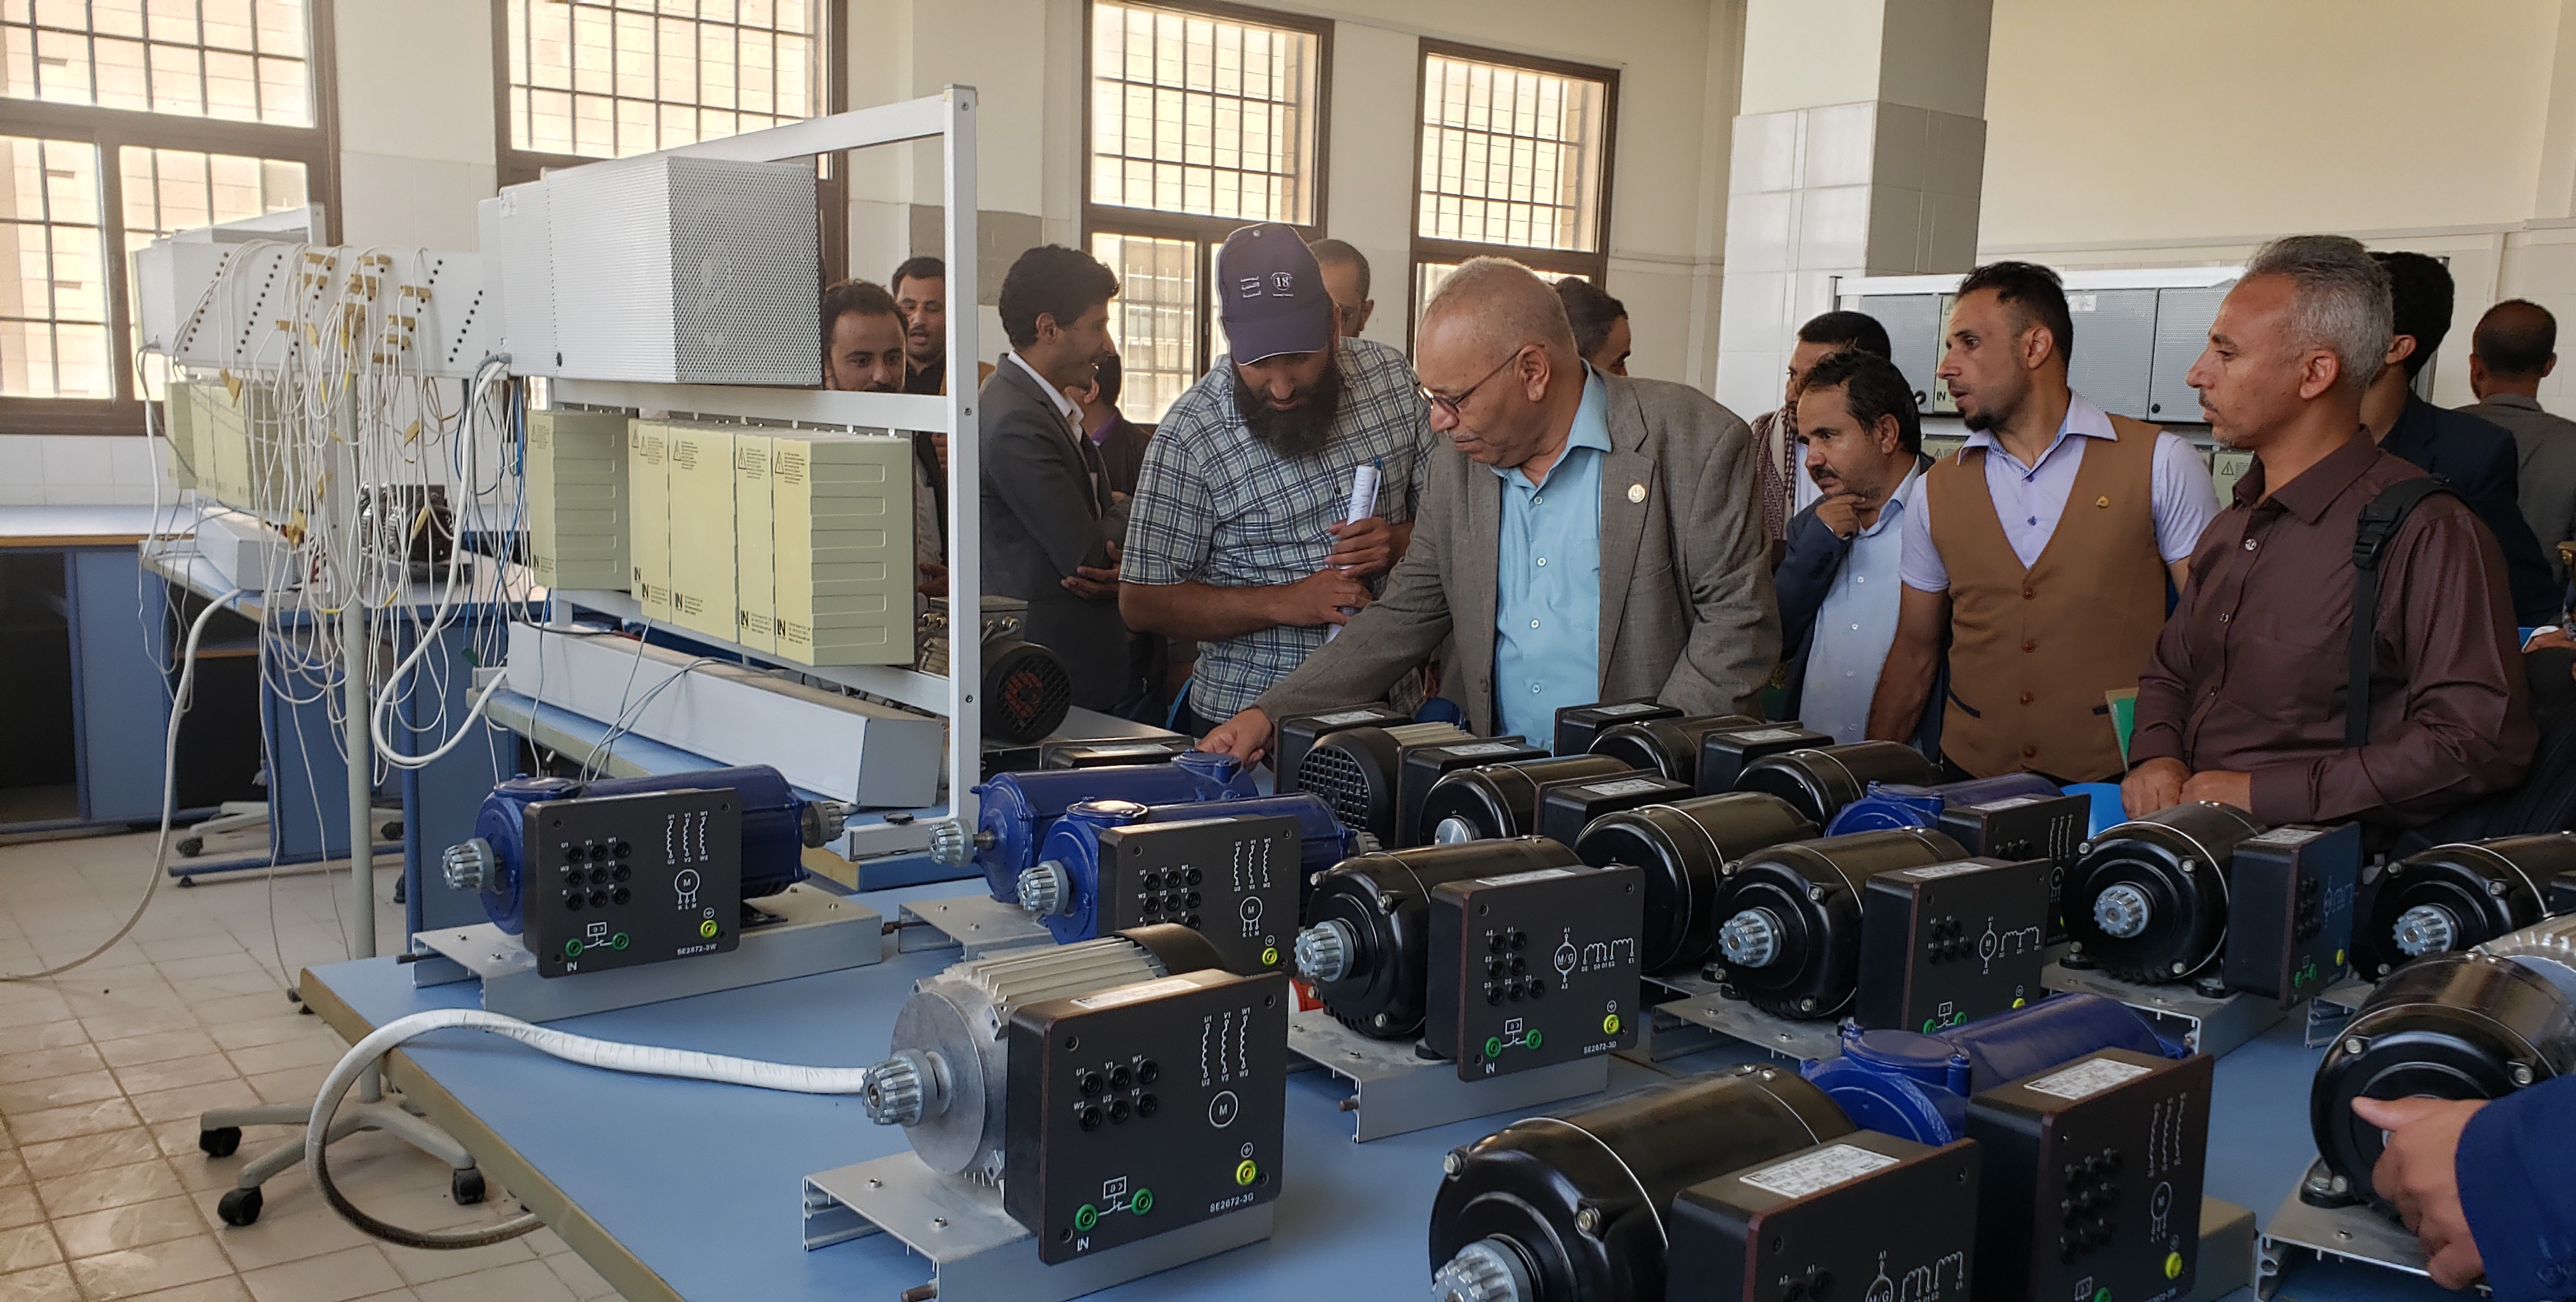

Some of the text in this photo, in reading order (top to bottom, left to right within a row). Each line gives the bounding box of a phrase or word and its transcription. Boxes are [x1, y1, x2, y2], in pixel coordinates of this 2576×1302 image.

[1276, 276, 1289, 288] 18
[683, 878, 691, 887] M
[1248, 905, 1254, 914] M
[1132, 1054, 1142, 1064] W1
[1105, 1061, 1113, 1070] V1
[1076, 1067, 1084, 1076] U1
[1239, 1069, 1248, 1077] W2
[1221, 1073, 1229, 1082] V2
[1201, 1078, 1210, 1087] U2
[1131, 1087, 1140, 1096] V2
[1103, 1094, 1112, 1103] U2
[1074, 1101, 1084, 1110] W2
[1219, 1103, 1227, 1116] M
[1806, 1264, 1814, 1275] A1
